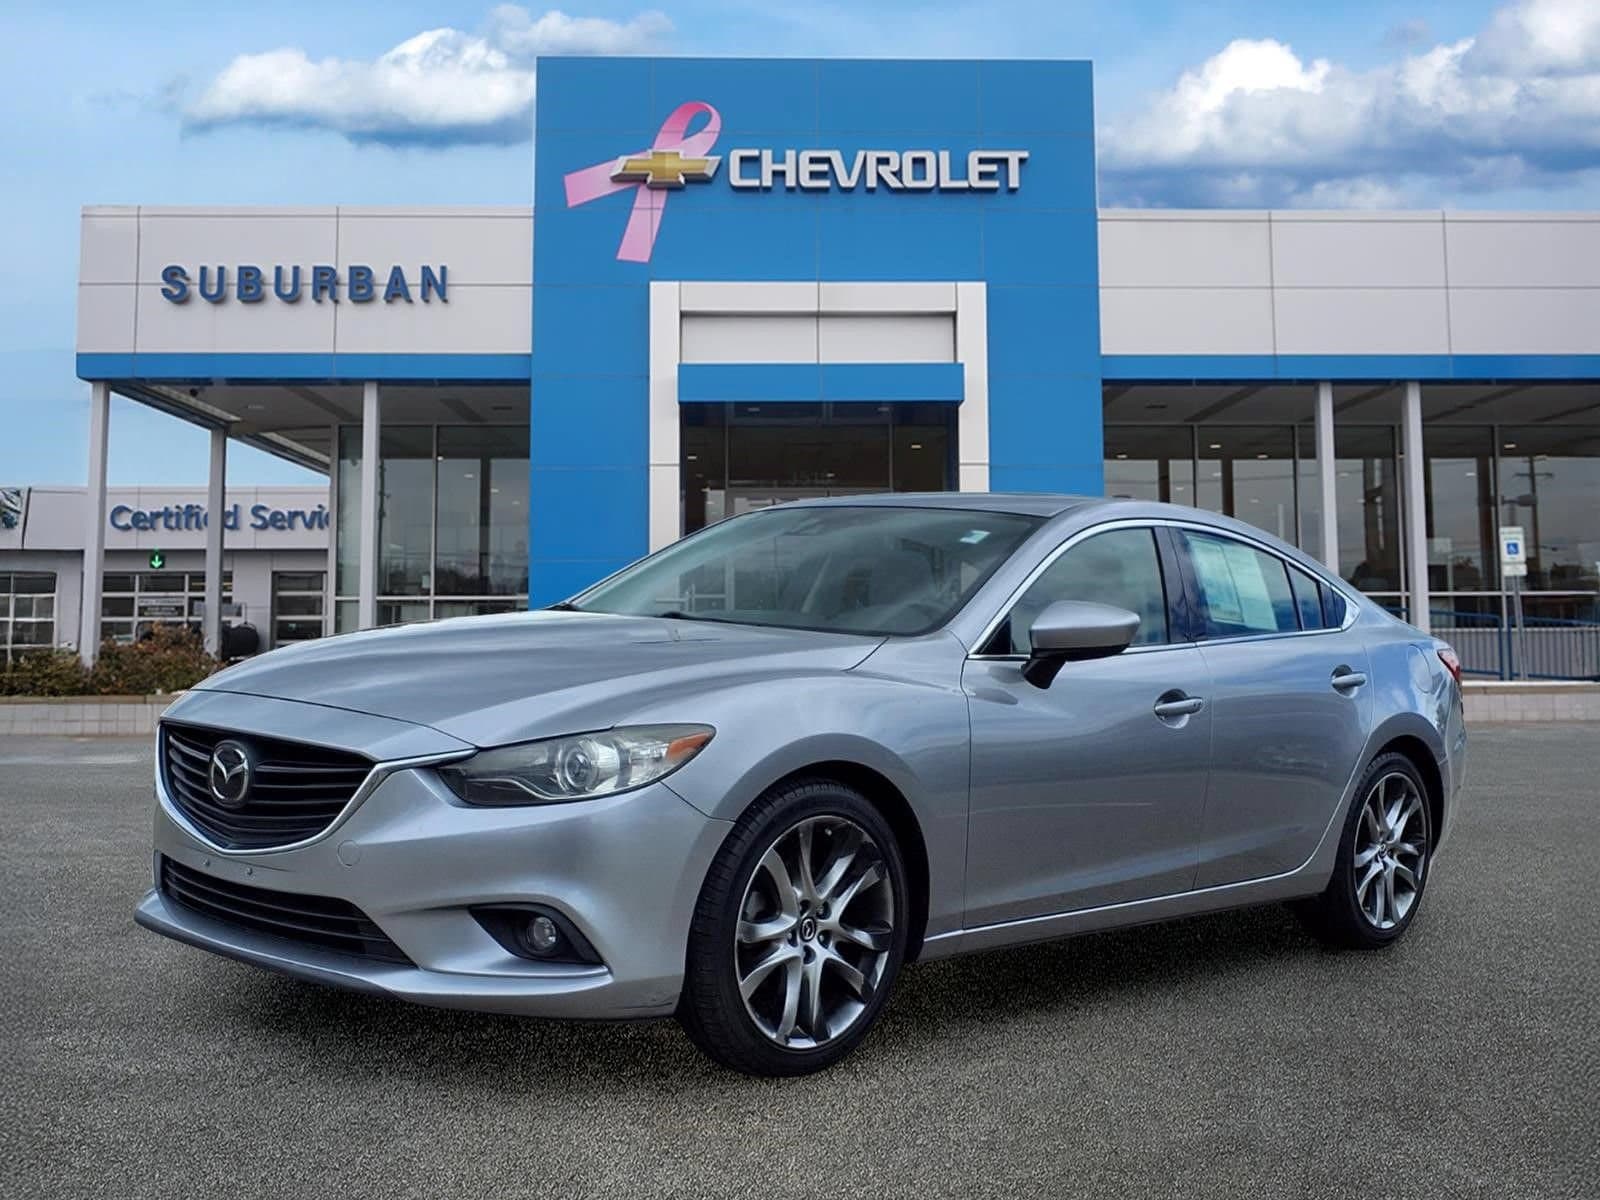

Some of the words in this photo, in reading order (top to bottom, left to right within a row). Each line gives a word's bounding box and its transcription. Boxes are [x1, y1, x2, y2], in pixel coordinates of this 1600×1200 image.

[729, 149, 1029, 191] CHEVROLET
[160, 264, 449, 303] SUBURBAN
[109, 503, 241, 531] Certifid
[250, 503, 329, 531] Servi
